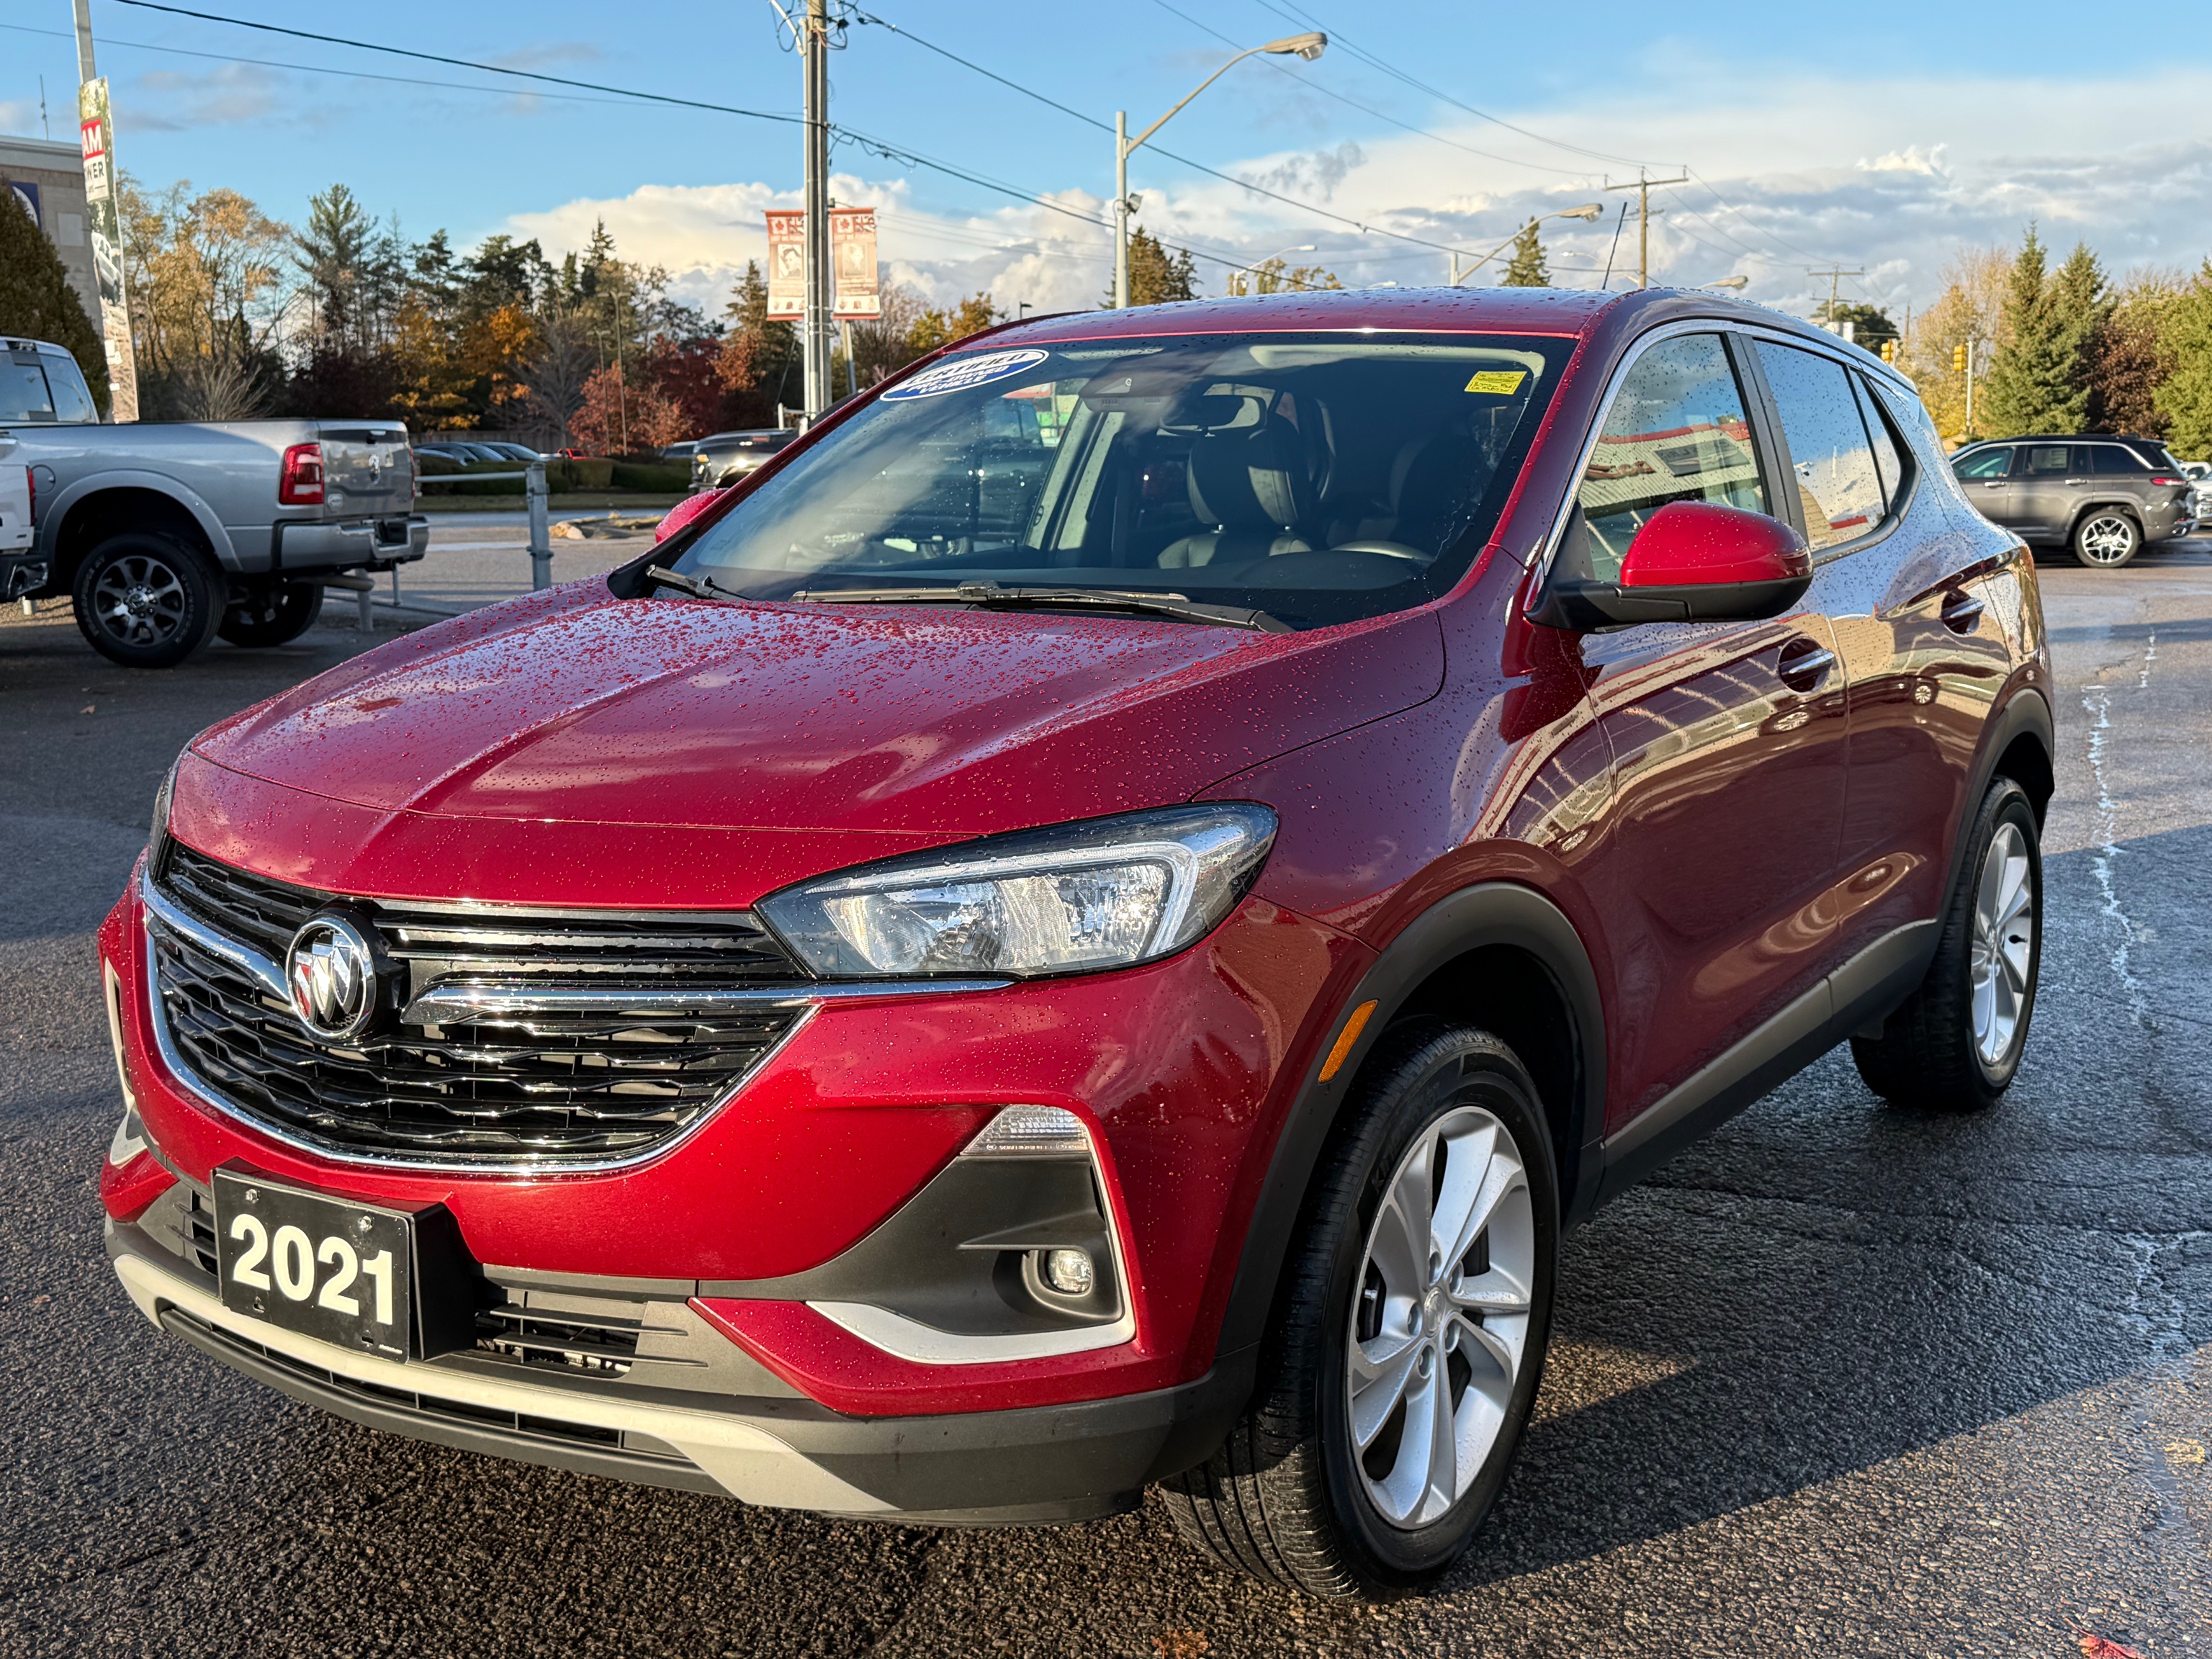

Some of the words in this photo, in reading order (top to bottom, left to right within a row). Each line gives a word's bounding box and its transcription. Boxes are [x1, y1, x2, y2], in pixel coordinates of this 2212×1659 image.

[906, 365, 1010, 393] PRE-OWNED
[907, 352, 1028, 385] CERTIFIED
[919, 374, 987, 394] VEHICLE
[231, 1213, 393, 1326] 2021
